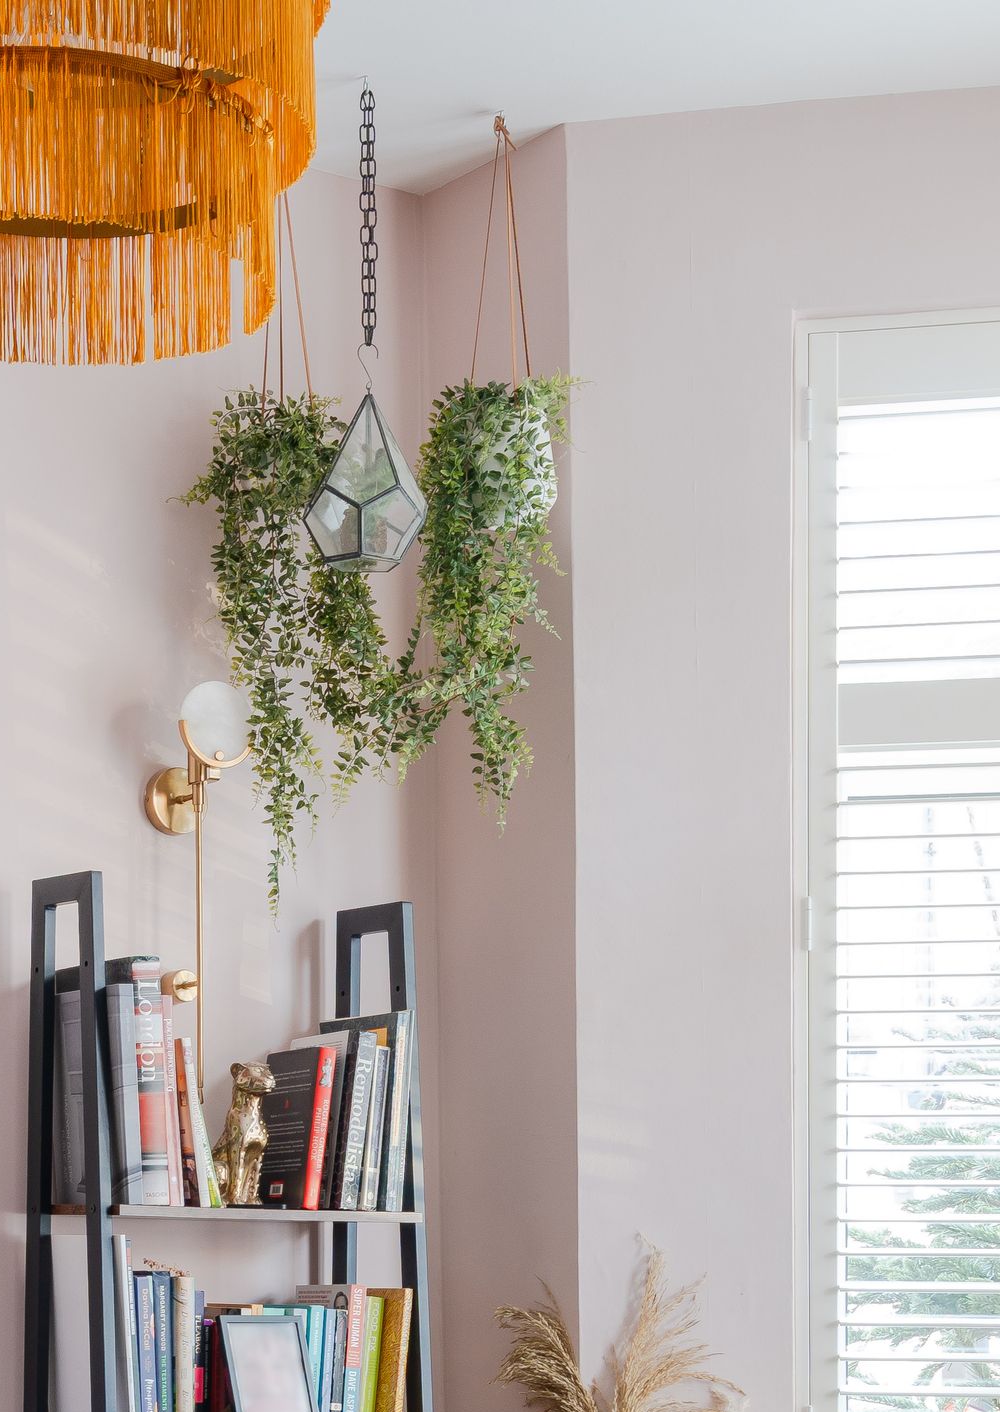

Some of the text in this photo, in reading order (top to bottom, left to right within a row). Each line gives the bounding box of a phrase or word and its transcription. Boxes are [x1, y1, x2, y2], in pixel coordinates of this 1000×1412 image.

[137, 979, 162, 1083] London
[311, 1107, 322, 1161] PHILIP HOOK
[344, 1058, 373, 1184] Remodelista
[159, 1285, 167, 1321] MARGARET
[351, 1288, 363, 1347] SUPER HUMAN
[369, 1302, 379, 1352] FOOD FIX
[143, 1321, 151, 1350] McCall
[194, 1314, 202, 1354] FLEABAG
[348, 1371, 357, 1391] DAVE
